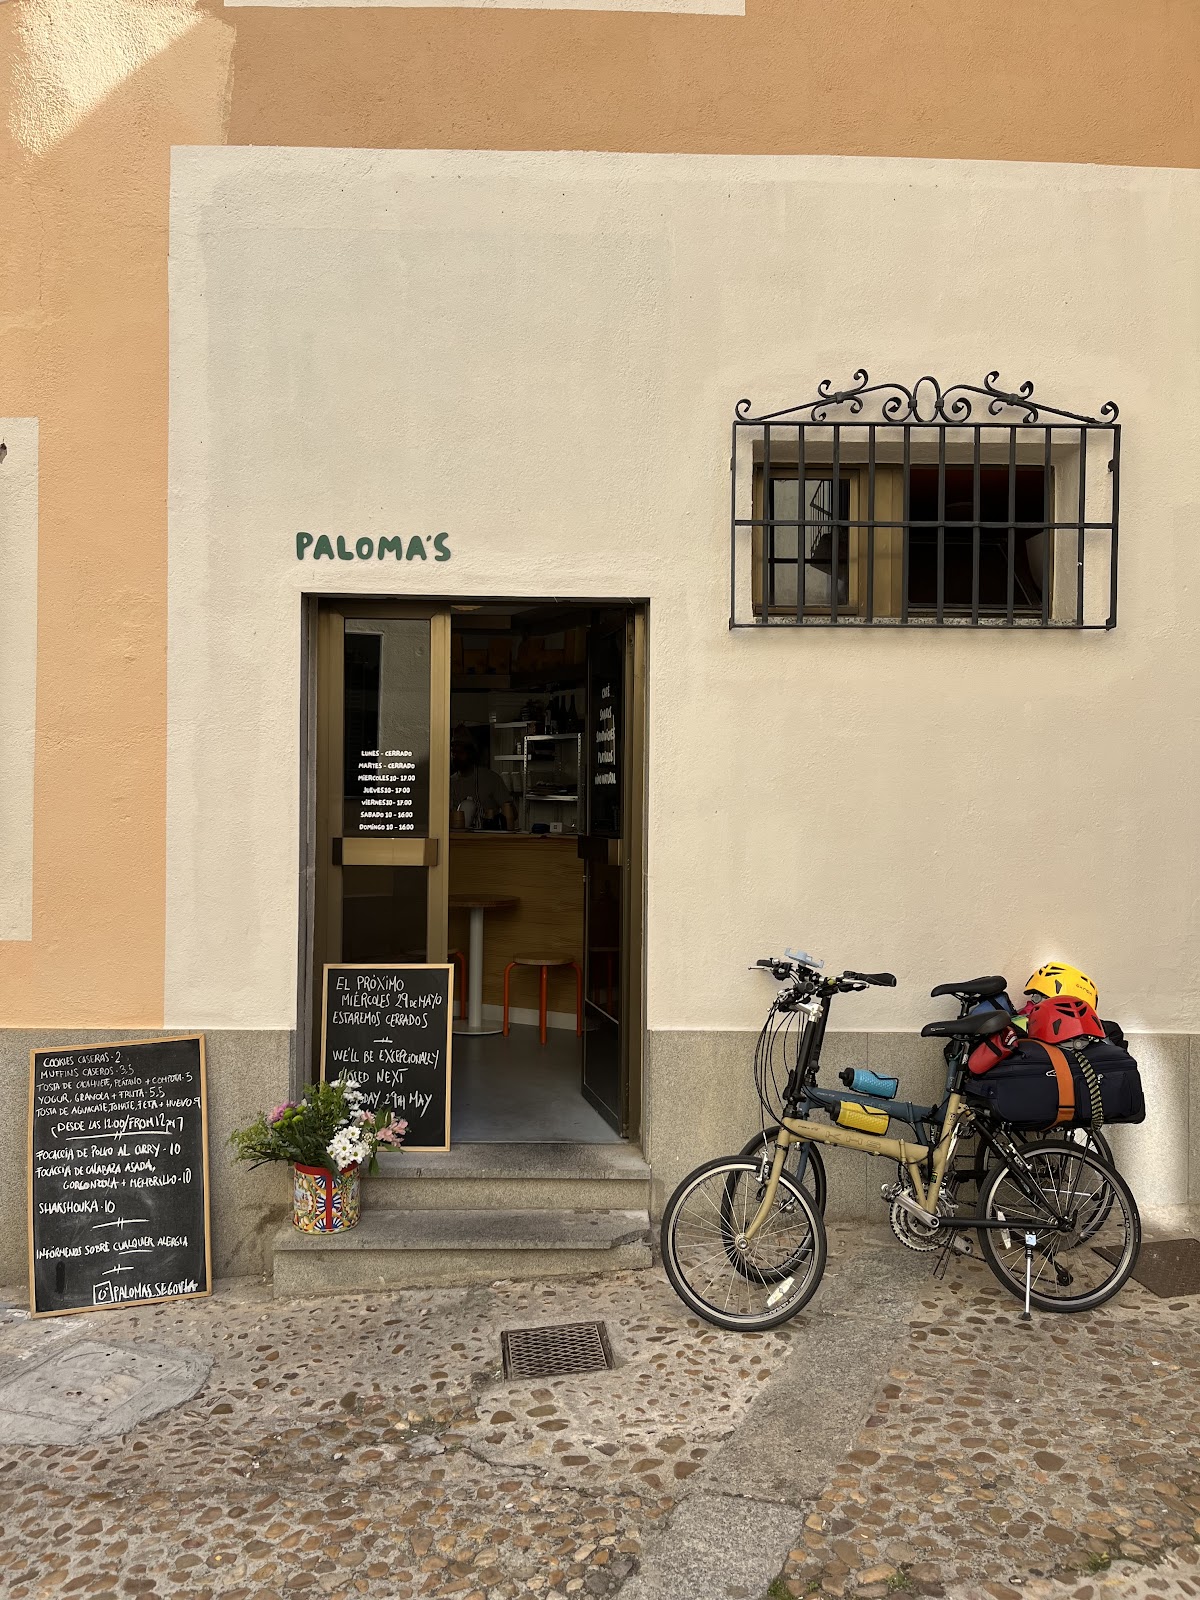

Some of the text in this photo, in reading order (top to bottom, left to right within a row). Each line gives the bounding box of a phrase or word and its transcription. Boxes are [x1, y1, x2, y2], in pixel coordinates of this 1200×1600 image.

[296, 532, 451, 561] PALOMA'S
[336, 974, 404, 992] EL PRÓXIMO
[341, 992, 442, 1009] MIÉRCOLES 29 DE MAYO
[332, 1011, 428, 1028] ESTAREMOS CERRADOS
[43, 1056, 74, 1067] COOKIES
[78, 1052, 109, 1064] CASERAS
[115, 1051, 121, 1064] 2
[332, 1047, 359, 1062] WE'LL
[364, 1050, 374, 1064] BE
[40, 1068, 79, 1079] MUFFINS
[82, 1066, 113, 1076] CASEROS
[377, 1068, 408, 1088] NEXT
[36, 1082, 60, 1092] TOSTA
[62, 1081, 72, 1089] DE
[75, 1092, 109, 1102] GRANOLA
[119, 1088, 144, 1099] FRUTA
[36, 1108, 57, 1117] TOSTA
[60, 1107, 69, 1116] DE
[409, 1090, 432, 1118] MAY
[88, 1120, 101, 1130] LAS
[825, 1131, 881, 1149] KHS
[36, 1147, 74, 1160] FOCACCIA
[76, 1148, 88, 1158] DE
[91, 1145, 113, 1157] POLLO
[118, 1144, 131, 1156] AL
[134, 1143, 160, 1157] CURRY
[170, 1142, 180, 1155] 10
[35, 1164, 71, 1178] FOCACCIA
[74, 1166, 84, 1176] DE
[86, 1162, 121, 1176] CALABAZA
[183, 1168, 192, 1183] 10
[39, 1199, 98, 1214] SHAKSHOUKA
[105, 1200, 116, 1213] 10
[84, 1241, 110, 1255] SOBRE
[157, 1235, 188, 1247] ALERGIA
